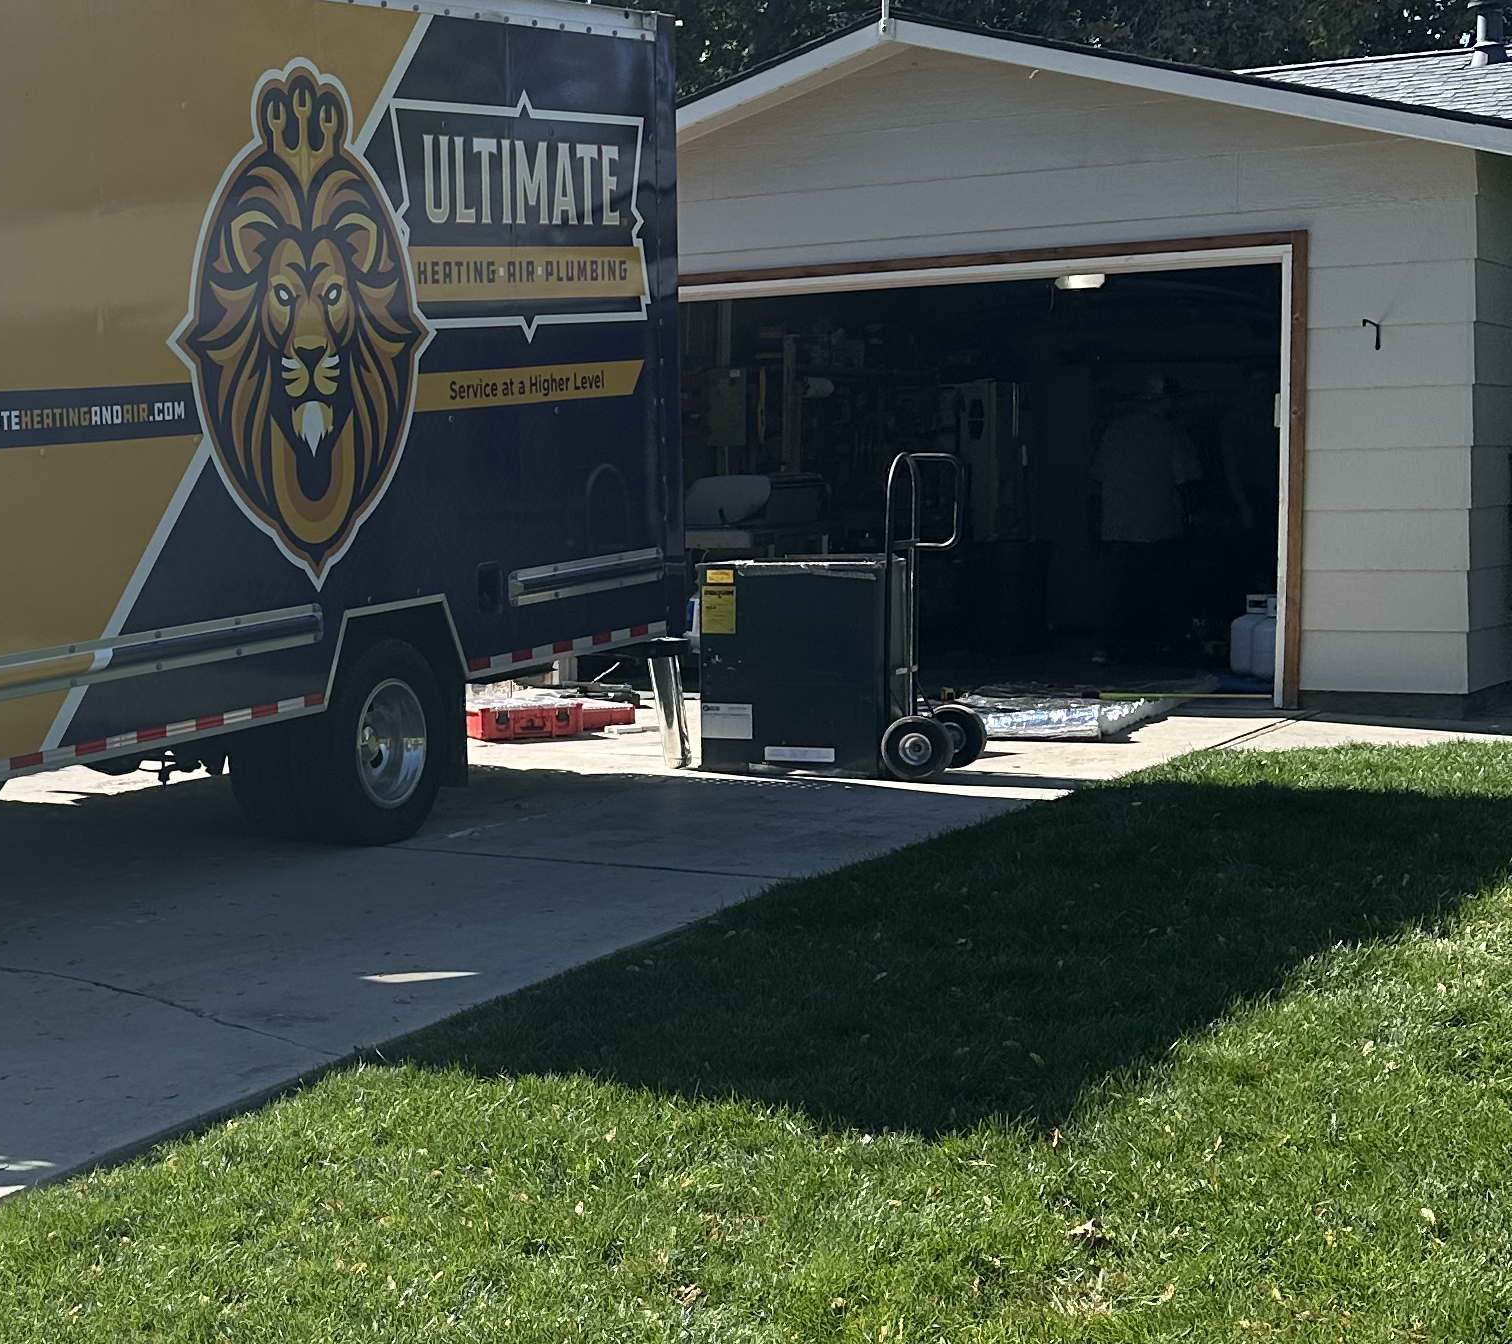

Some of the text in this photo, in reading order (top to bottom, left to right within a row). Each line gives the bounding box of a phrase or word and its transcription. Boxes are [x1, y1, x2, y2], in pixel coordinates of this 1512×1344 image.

[423, 134, 620, 225] ULTIMATE
[417, 259, 628, 285] HEATING AIR PLUMBING
[449, 370, 605, 400] Service at a Higher Level
